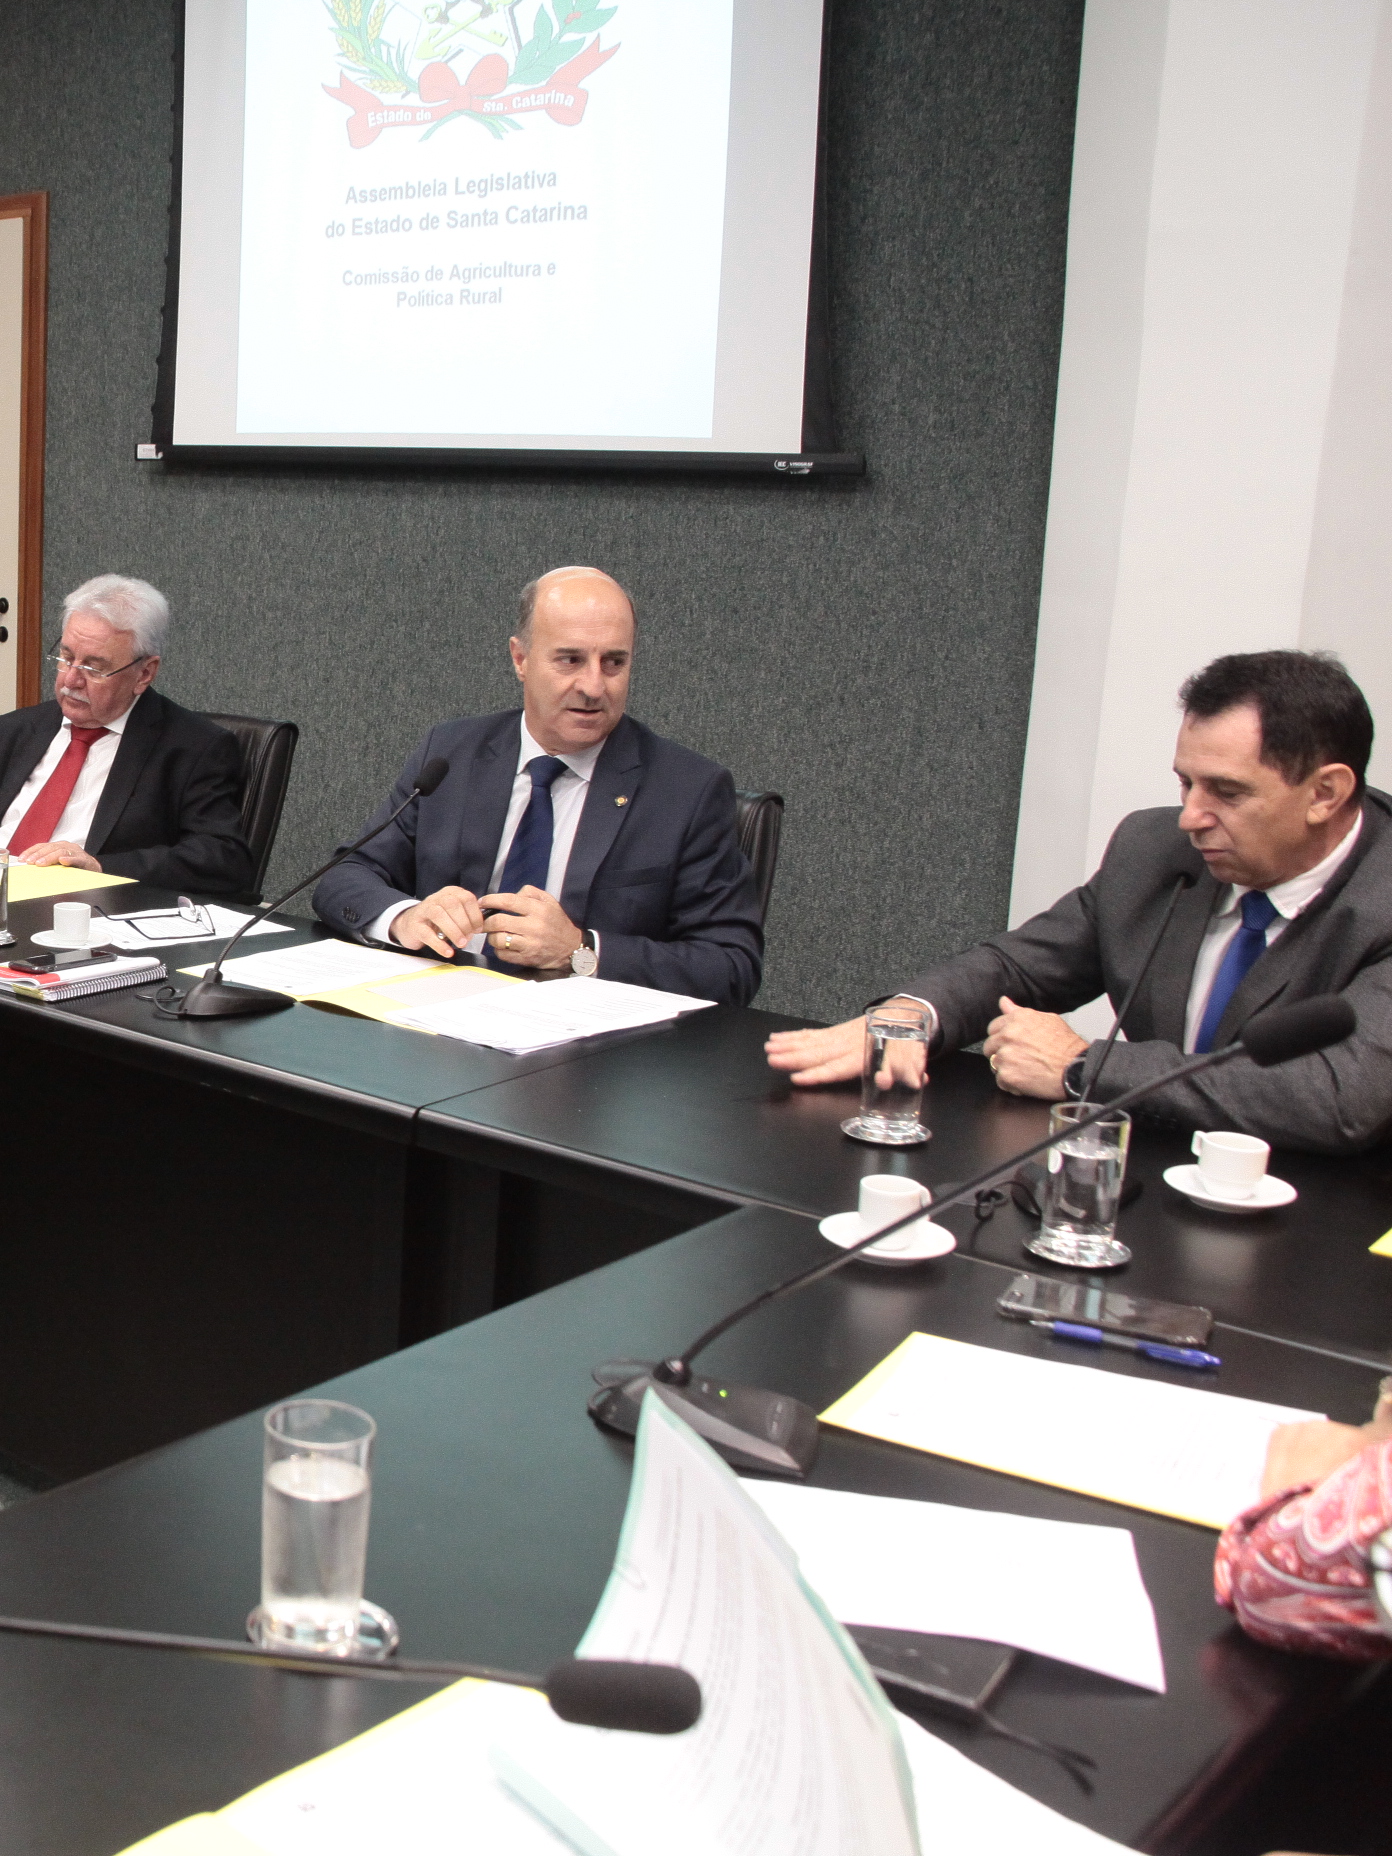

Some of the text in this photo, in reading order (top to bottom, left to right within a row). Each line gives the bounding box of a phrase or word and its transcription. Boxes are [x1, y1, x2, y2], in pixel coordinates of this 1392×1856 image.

[367, 108, 412, 129] Estado
[415, 109, 432, 122] do
[511, 90, 575, 109] Catarina
[345, 169, 557, 205] Assembleia Legislativa
[325, 201, 588, 239] do Estado de Santa Catarina
[342, 260, 557, 286] Comissão de Agricultura e
[396, 286, 503, 309] Política Rural
